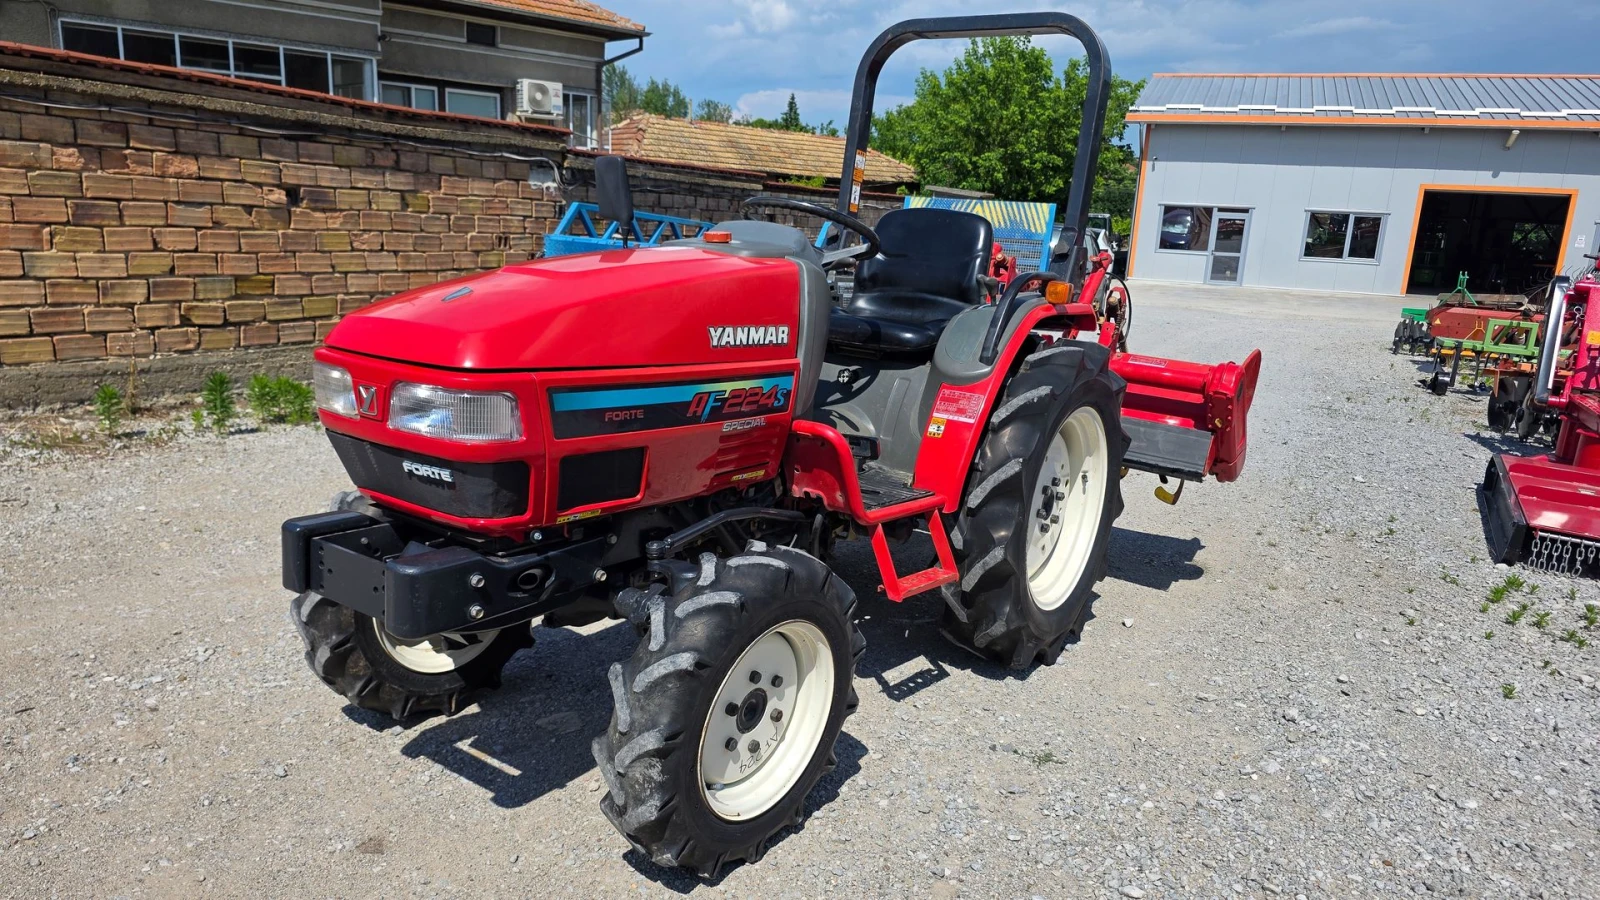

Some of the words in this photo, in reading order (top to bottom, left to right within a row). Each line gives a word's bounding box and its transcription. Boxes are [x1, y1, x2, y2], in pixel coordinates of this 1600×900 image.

[708, 326, 789, 347] YANMAR
[605, 410, 645, 422] FORTE
[722, 418, 766, 432] SPECIAL
[402, 460, 454, 483] FORTE
